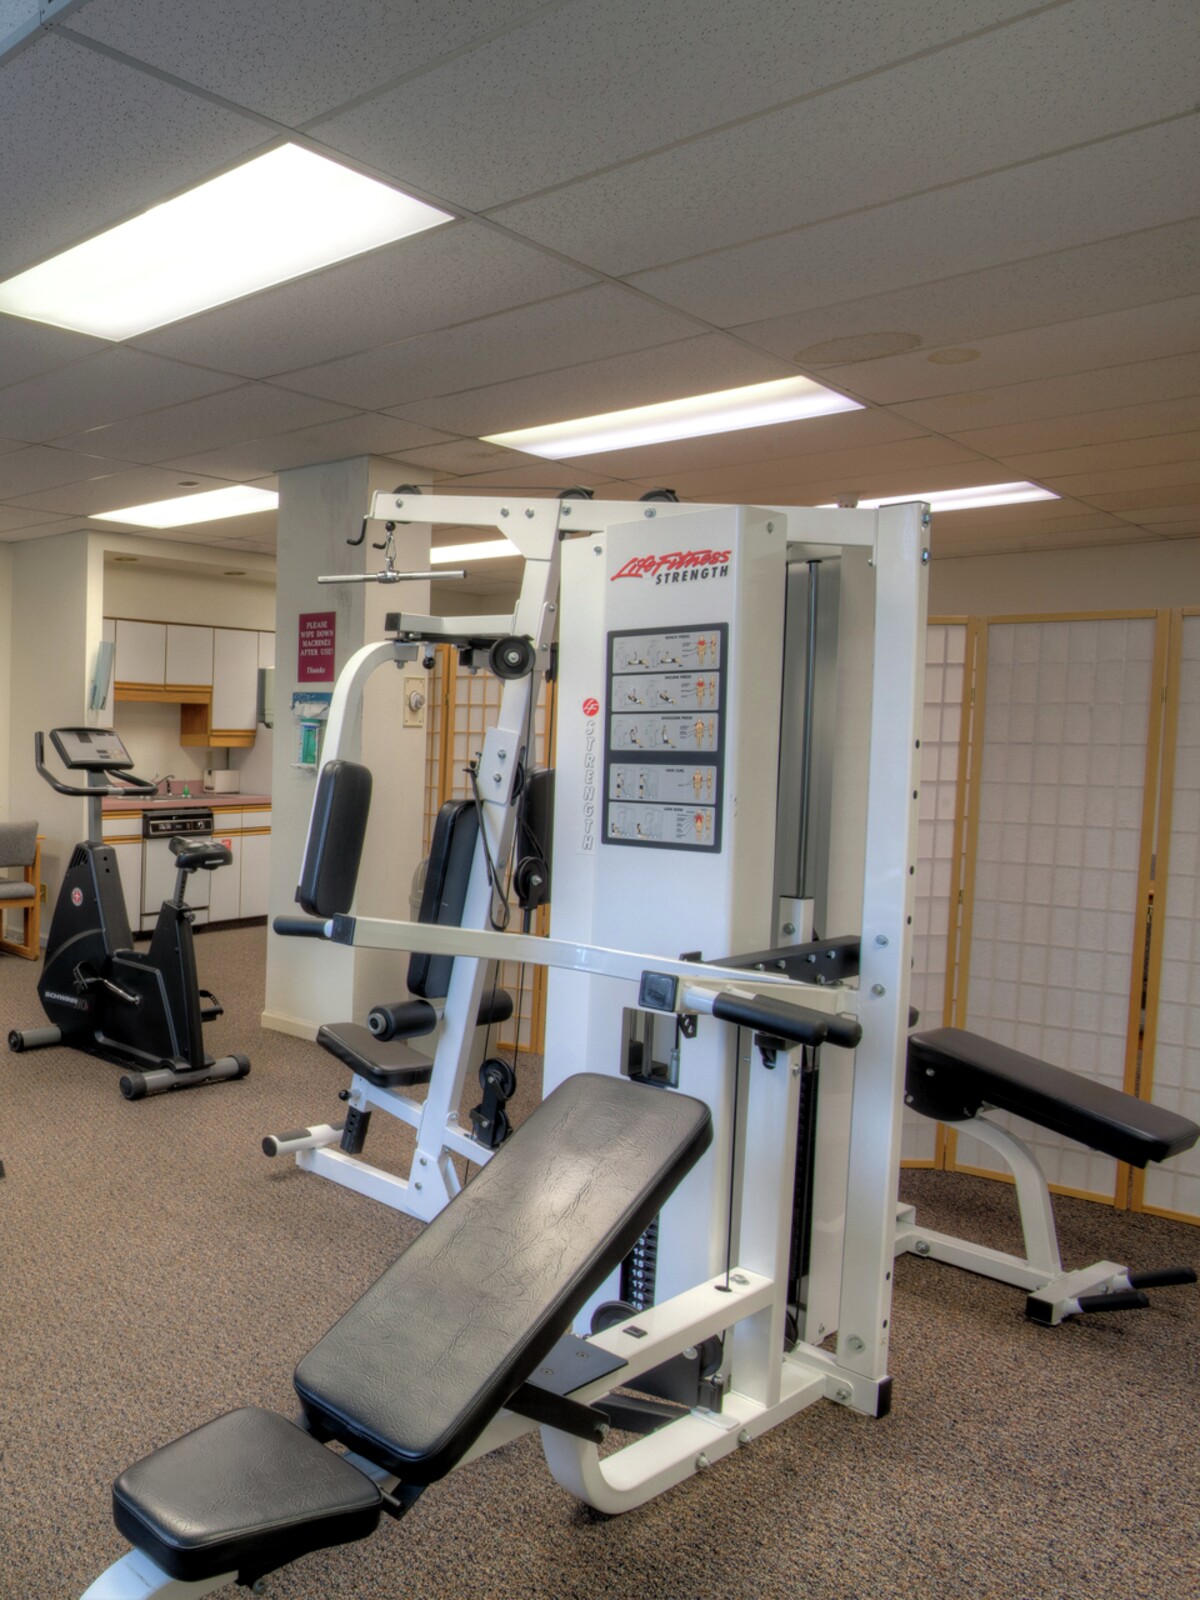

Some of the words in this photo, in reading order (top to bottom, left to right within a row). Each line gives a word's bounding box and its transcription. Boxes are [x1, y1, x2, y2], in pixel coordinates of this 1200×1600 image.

[655, 565, 729, 585] STRENGTH
[306, 621, 328, 629] PLEASE
[302, 639, 331, 647] MACHINES
[300, 648, 319, 656] AFTER
[582, 720, 596, 850] STRENGTH
[632, 1280, 644, 1289] 17
